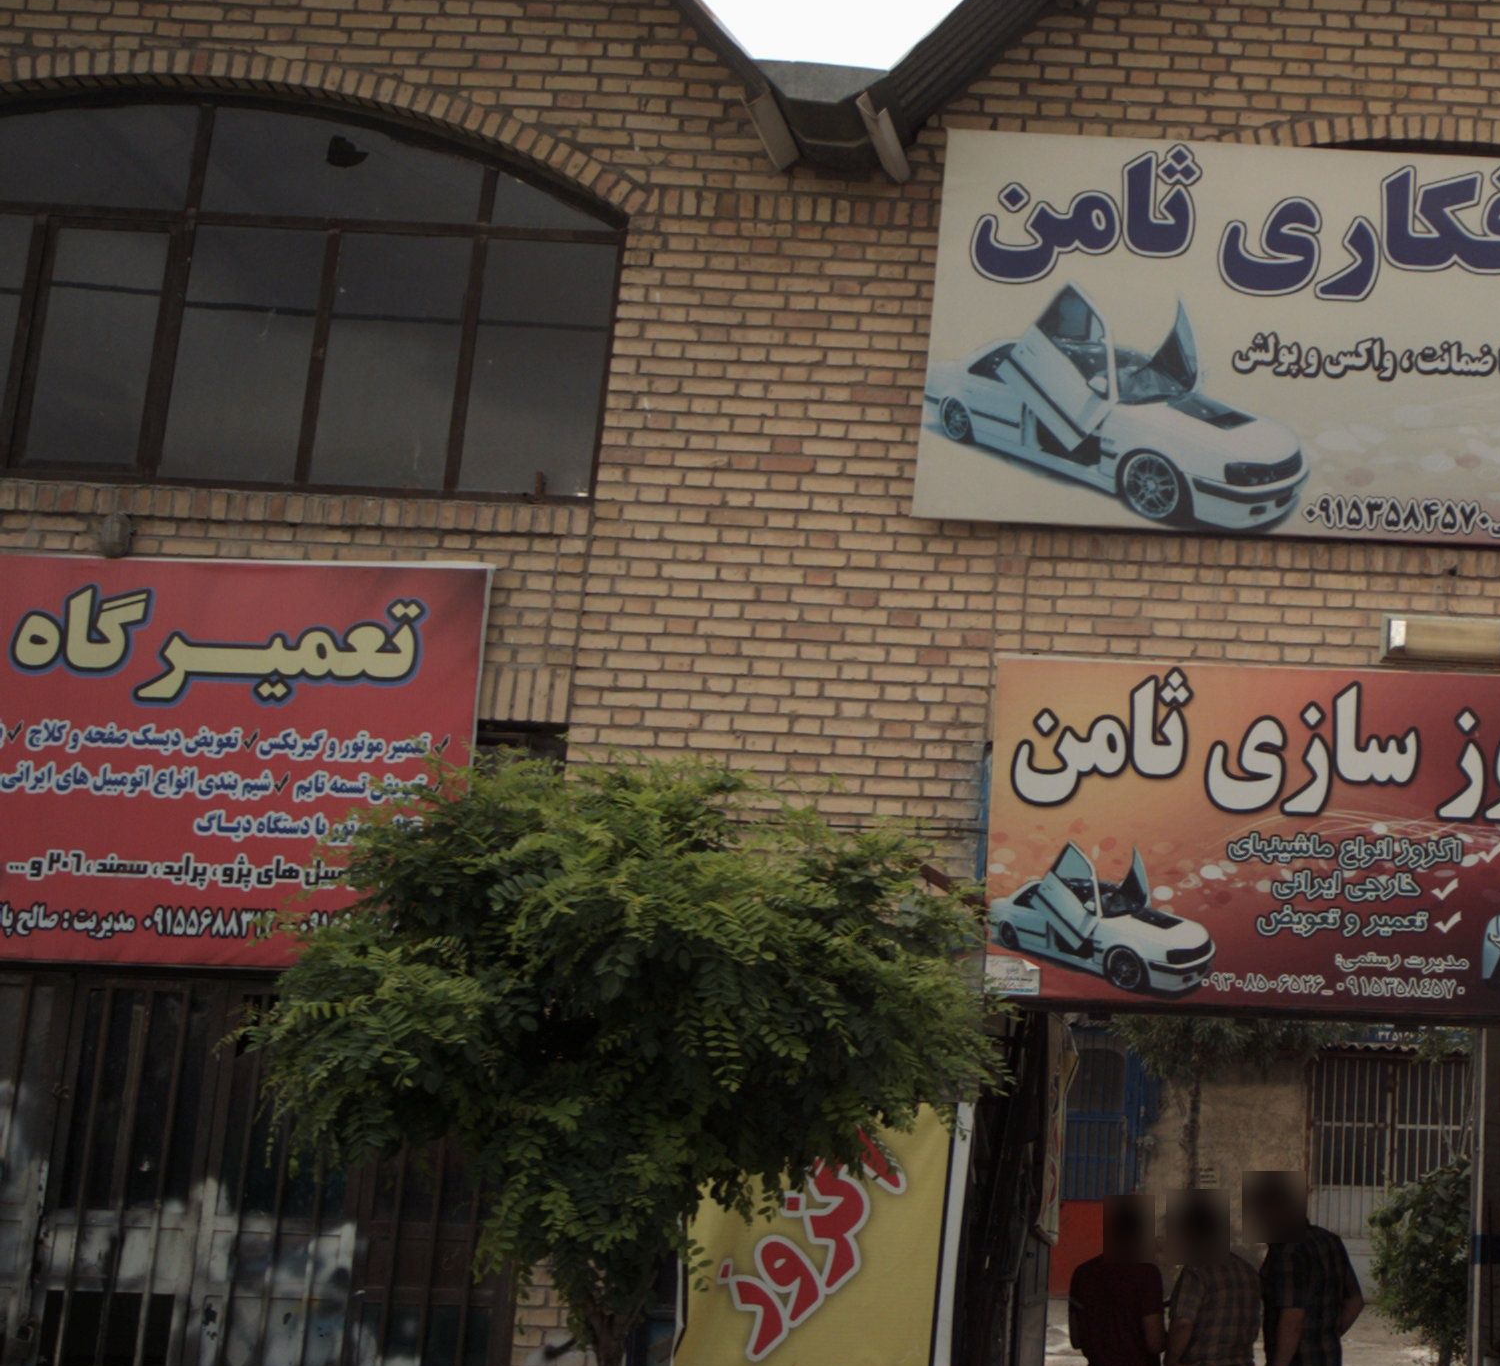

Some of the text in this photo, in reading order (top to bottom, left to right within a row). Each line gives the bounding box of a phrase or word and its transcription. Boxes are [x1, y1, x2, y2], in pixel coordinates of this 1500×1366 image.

[970, 143, 1202, 284] ثامن
[1232, 332, 1301, 378] پولش
[1323, 337, 1397, 381] واکس
[27, 719, 69, 751] کلاچ
[66, 729, 81, 752] و
[84, 722, 130, 745] صفحه
[131, 722, 182, 755] دیسک
[185, 726, 242, 757] تعویض
[325, 737, 338, 760] و
[340, 731, 384, 760] موتور
[1009, 666, 1194, 807] ثامن
[1203, 680, 1421, 817] سازی
[0, 760, 55, 793] ایرانی
[55, 764, 90, 795] های
[93, 763, 152, 797] اتومبیل
[153, 766, 197, 798] انواع
[198, 772, 239, 800] بندی
[241, 769, 272, 800] شیم
[294, 770, 329, 802] تایم
[329, 773, 370, 798] تسمه
[193, 808, 254, 842] دیاگ
[256, 812, 313, 837] دستگاه
[1227, 832, 1463, 868] اگزوز انواع ماشینهای
[256, 855, 300, 887] های
[1271, 869, 1421, 902] خارجی ایرانی
[16, 901, 60, 935] صالح
[1256, 905, 1429, 937] تعمیر و تعویض
